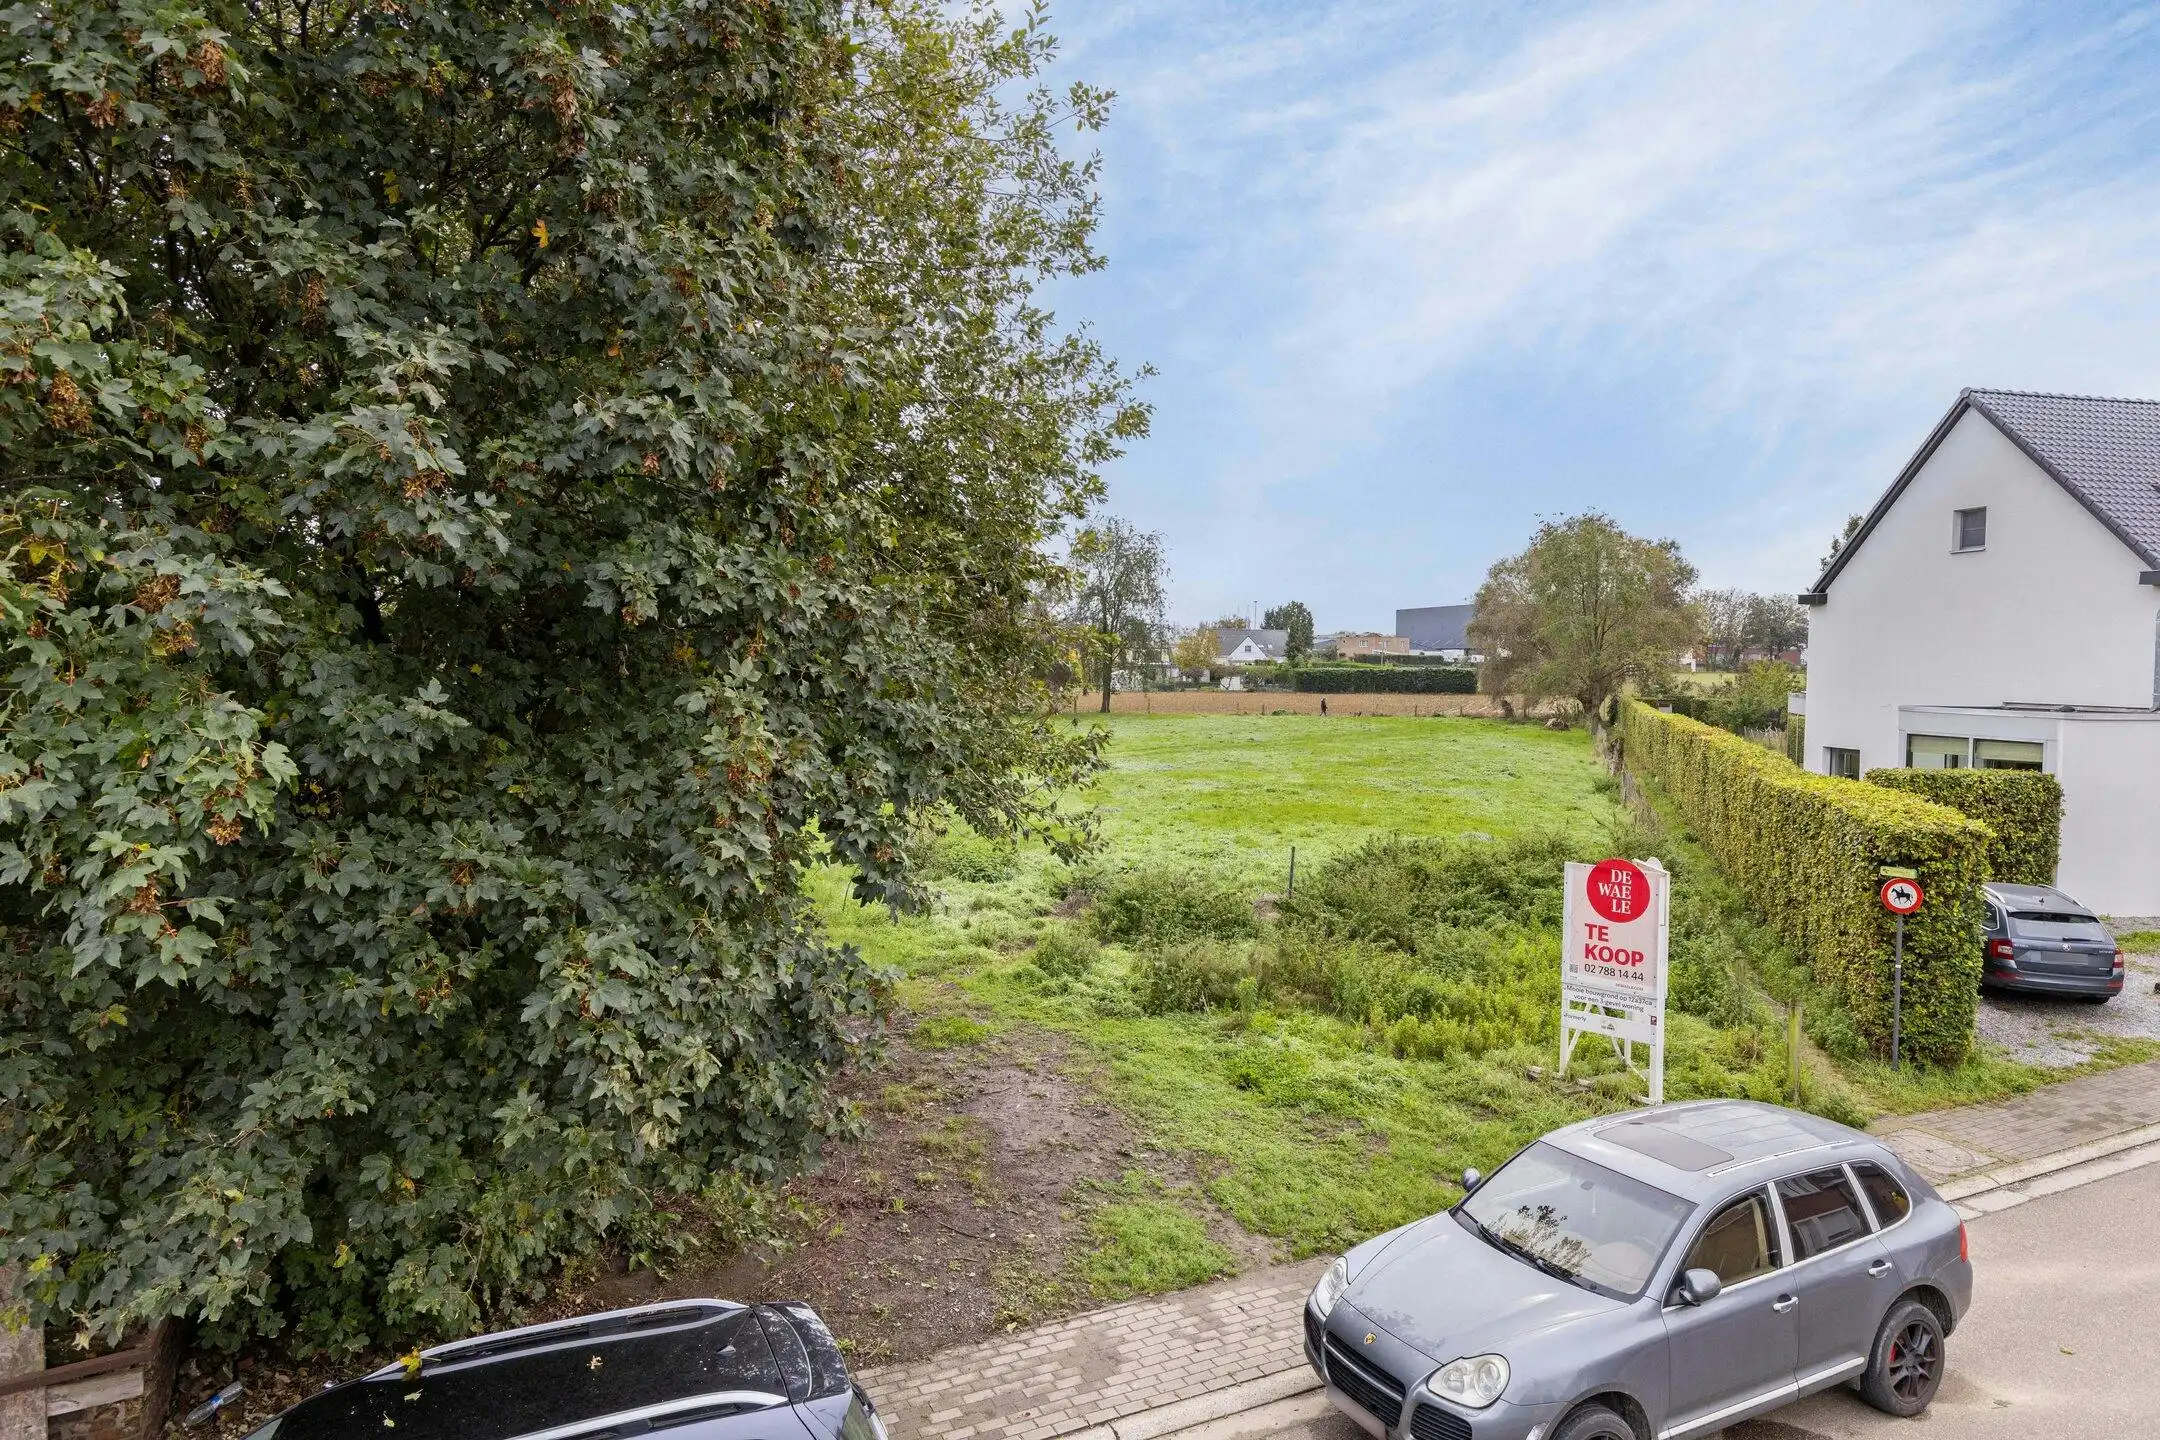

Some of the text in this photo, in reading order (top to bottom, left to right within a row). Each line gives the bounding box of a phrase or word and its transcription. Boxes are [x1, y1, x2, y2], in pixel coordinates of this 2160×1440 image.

[1611, 869, 1632, 885] DE
[1598, 882, 1632, 900] WAE
[1611, 899, 1631, 914] LE
[1584, 923, 1609, 942] TE
[1584, 943, 1645, 967] KOOP
[1584, 963, 1644, 981] 02 788 14 44
[1585, 988, 1618, 1000] bouwgrond
[1621, 1003, 1644, 1013] woning
